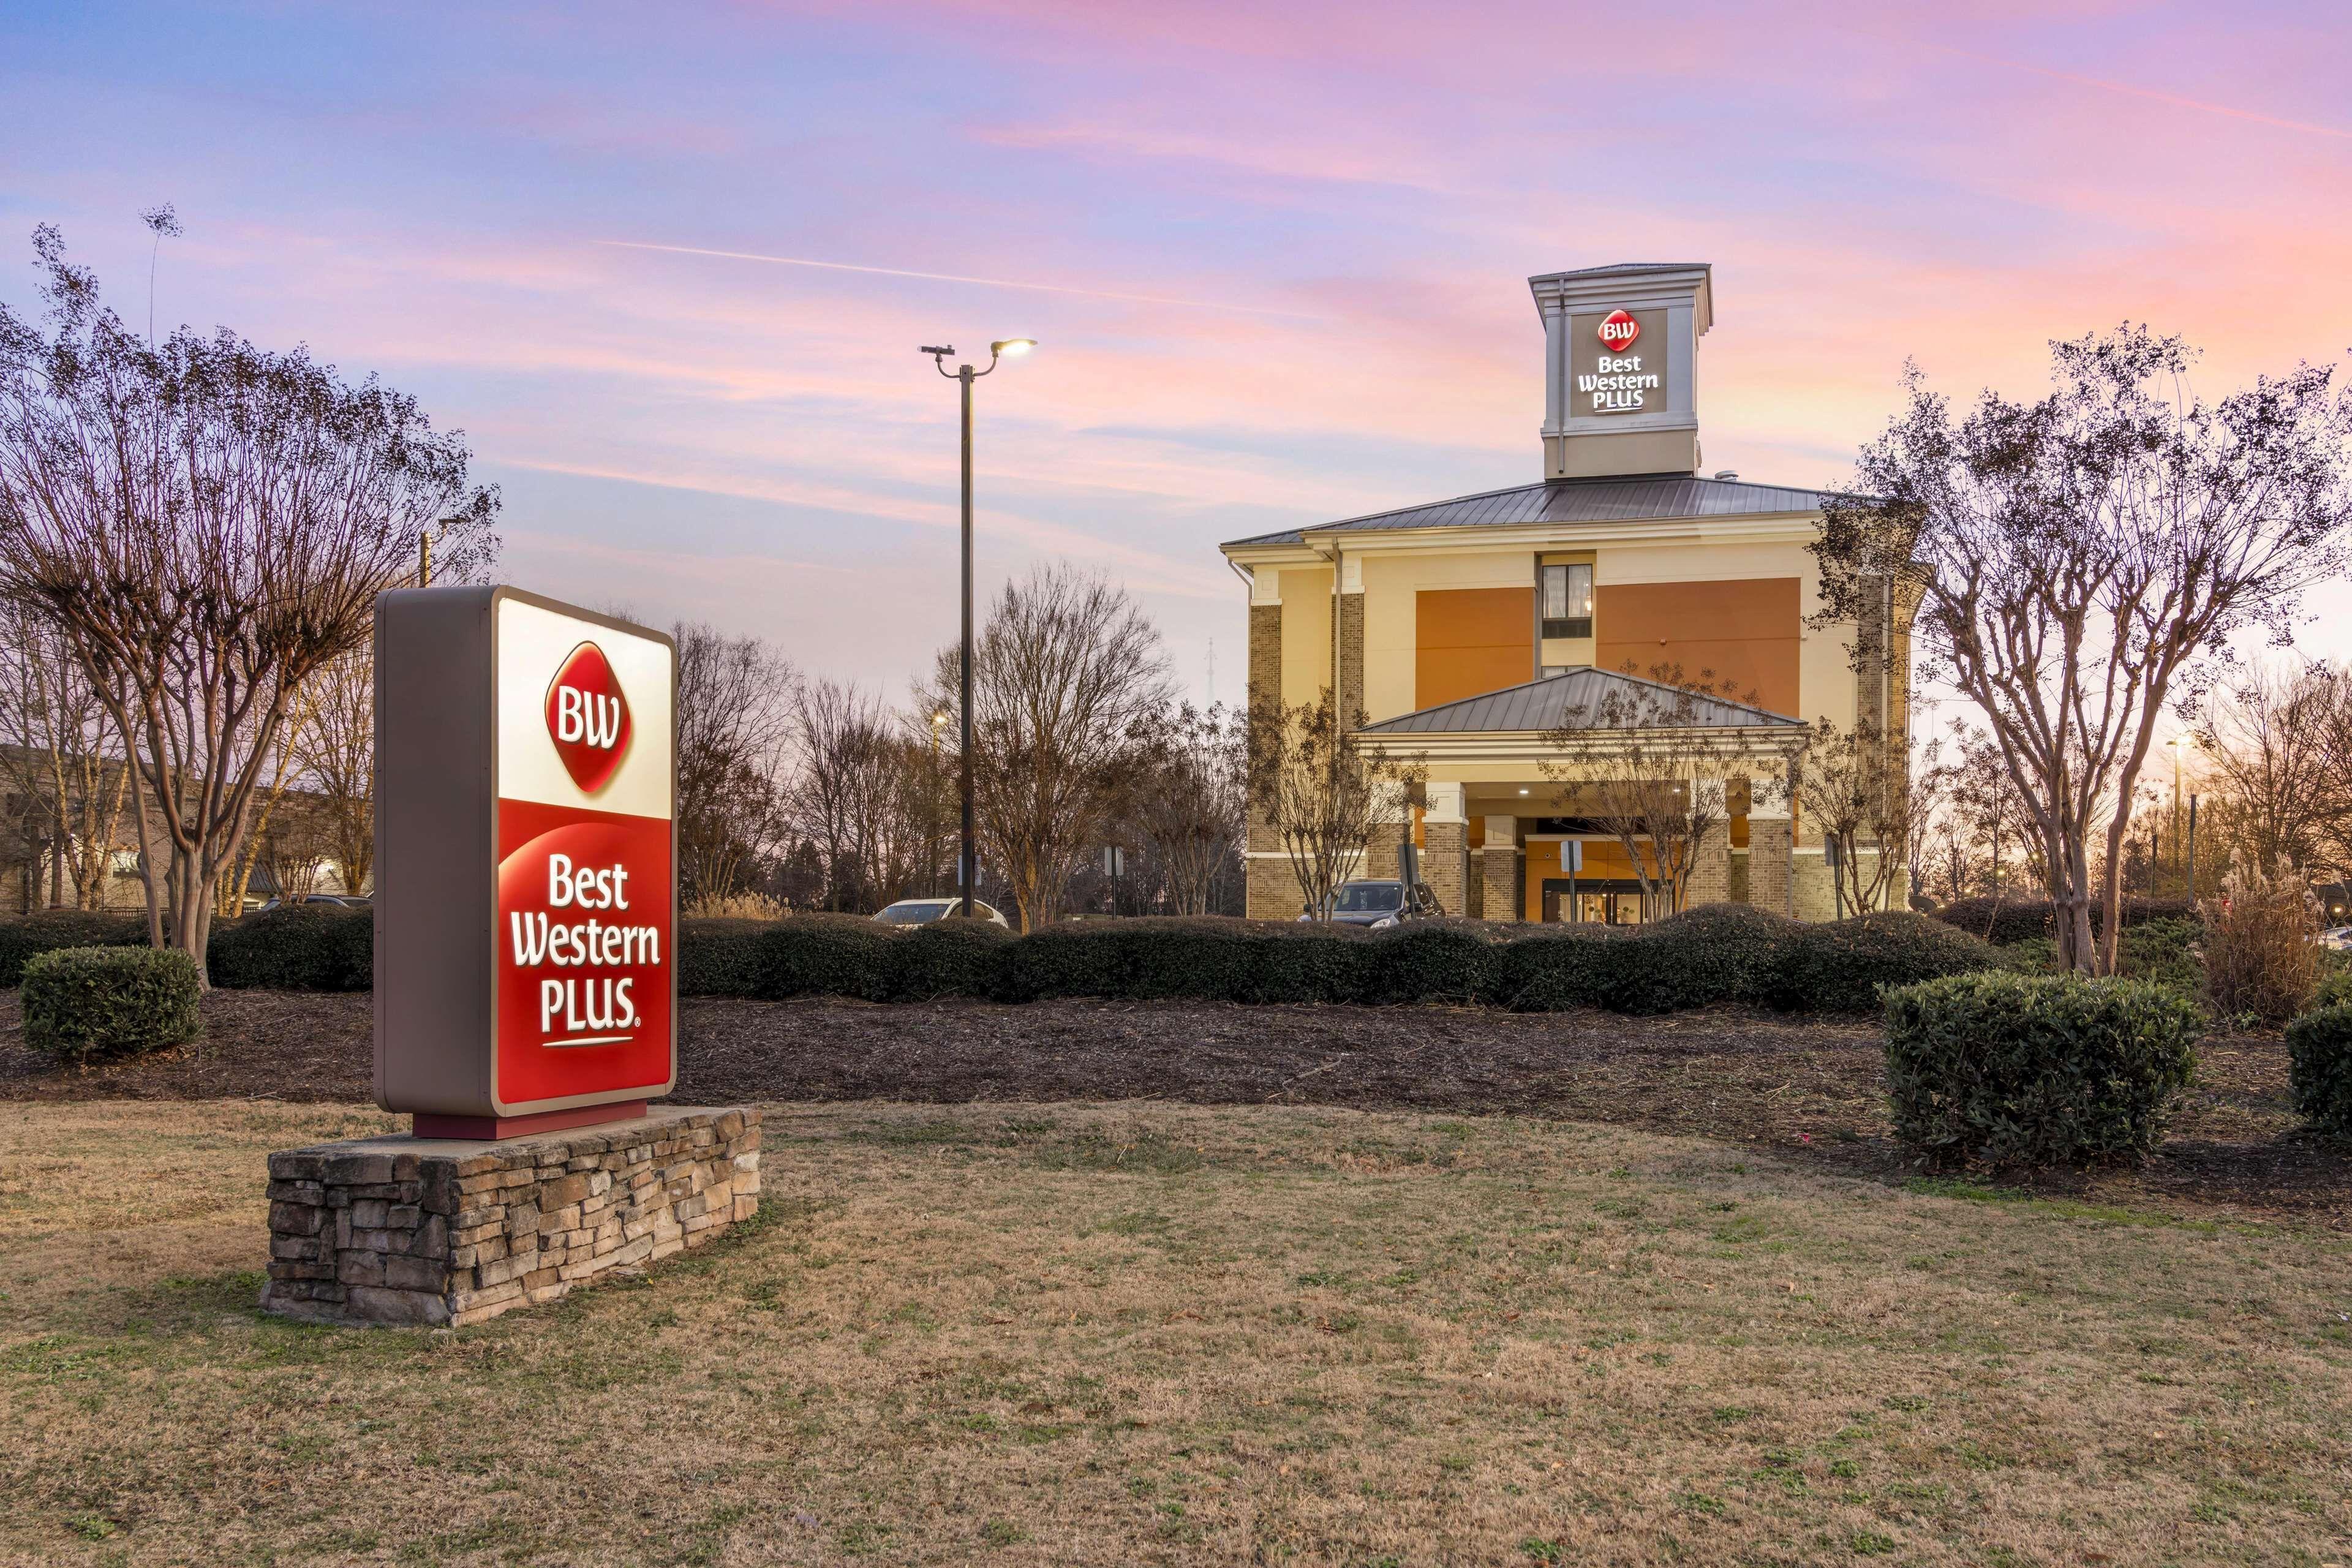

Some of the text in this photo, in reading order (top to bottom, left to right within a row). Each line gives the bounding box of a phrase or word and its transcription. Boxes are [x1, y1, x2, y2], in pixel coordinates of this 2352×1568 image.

[1604, 322, 1634, 340] BW
[1599, 356, 1642, 373] Best
[1578, 374, 1658, 391] Western
[1593, 390, 1643, 409] PLUS
[558, 685, 620, 749] BW
[549, 854, 628, 910] Best
[511, 911, 660, 965] Western
